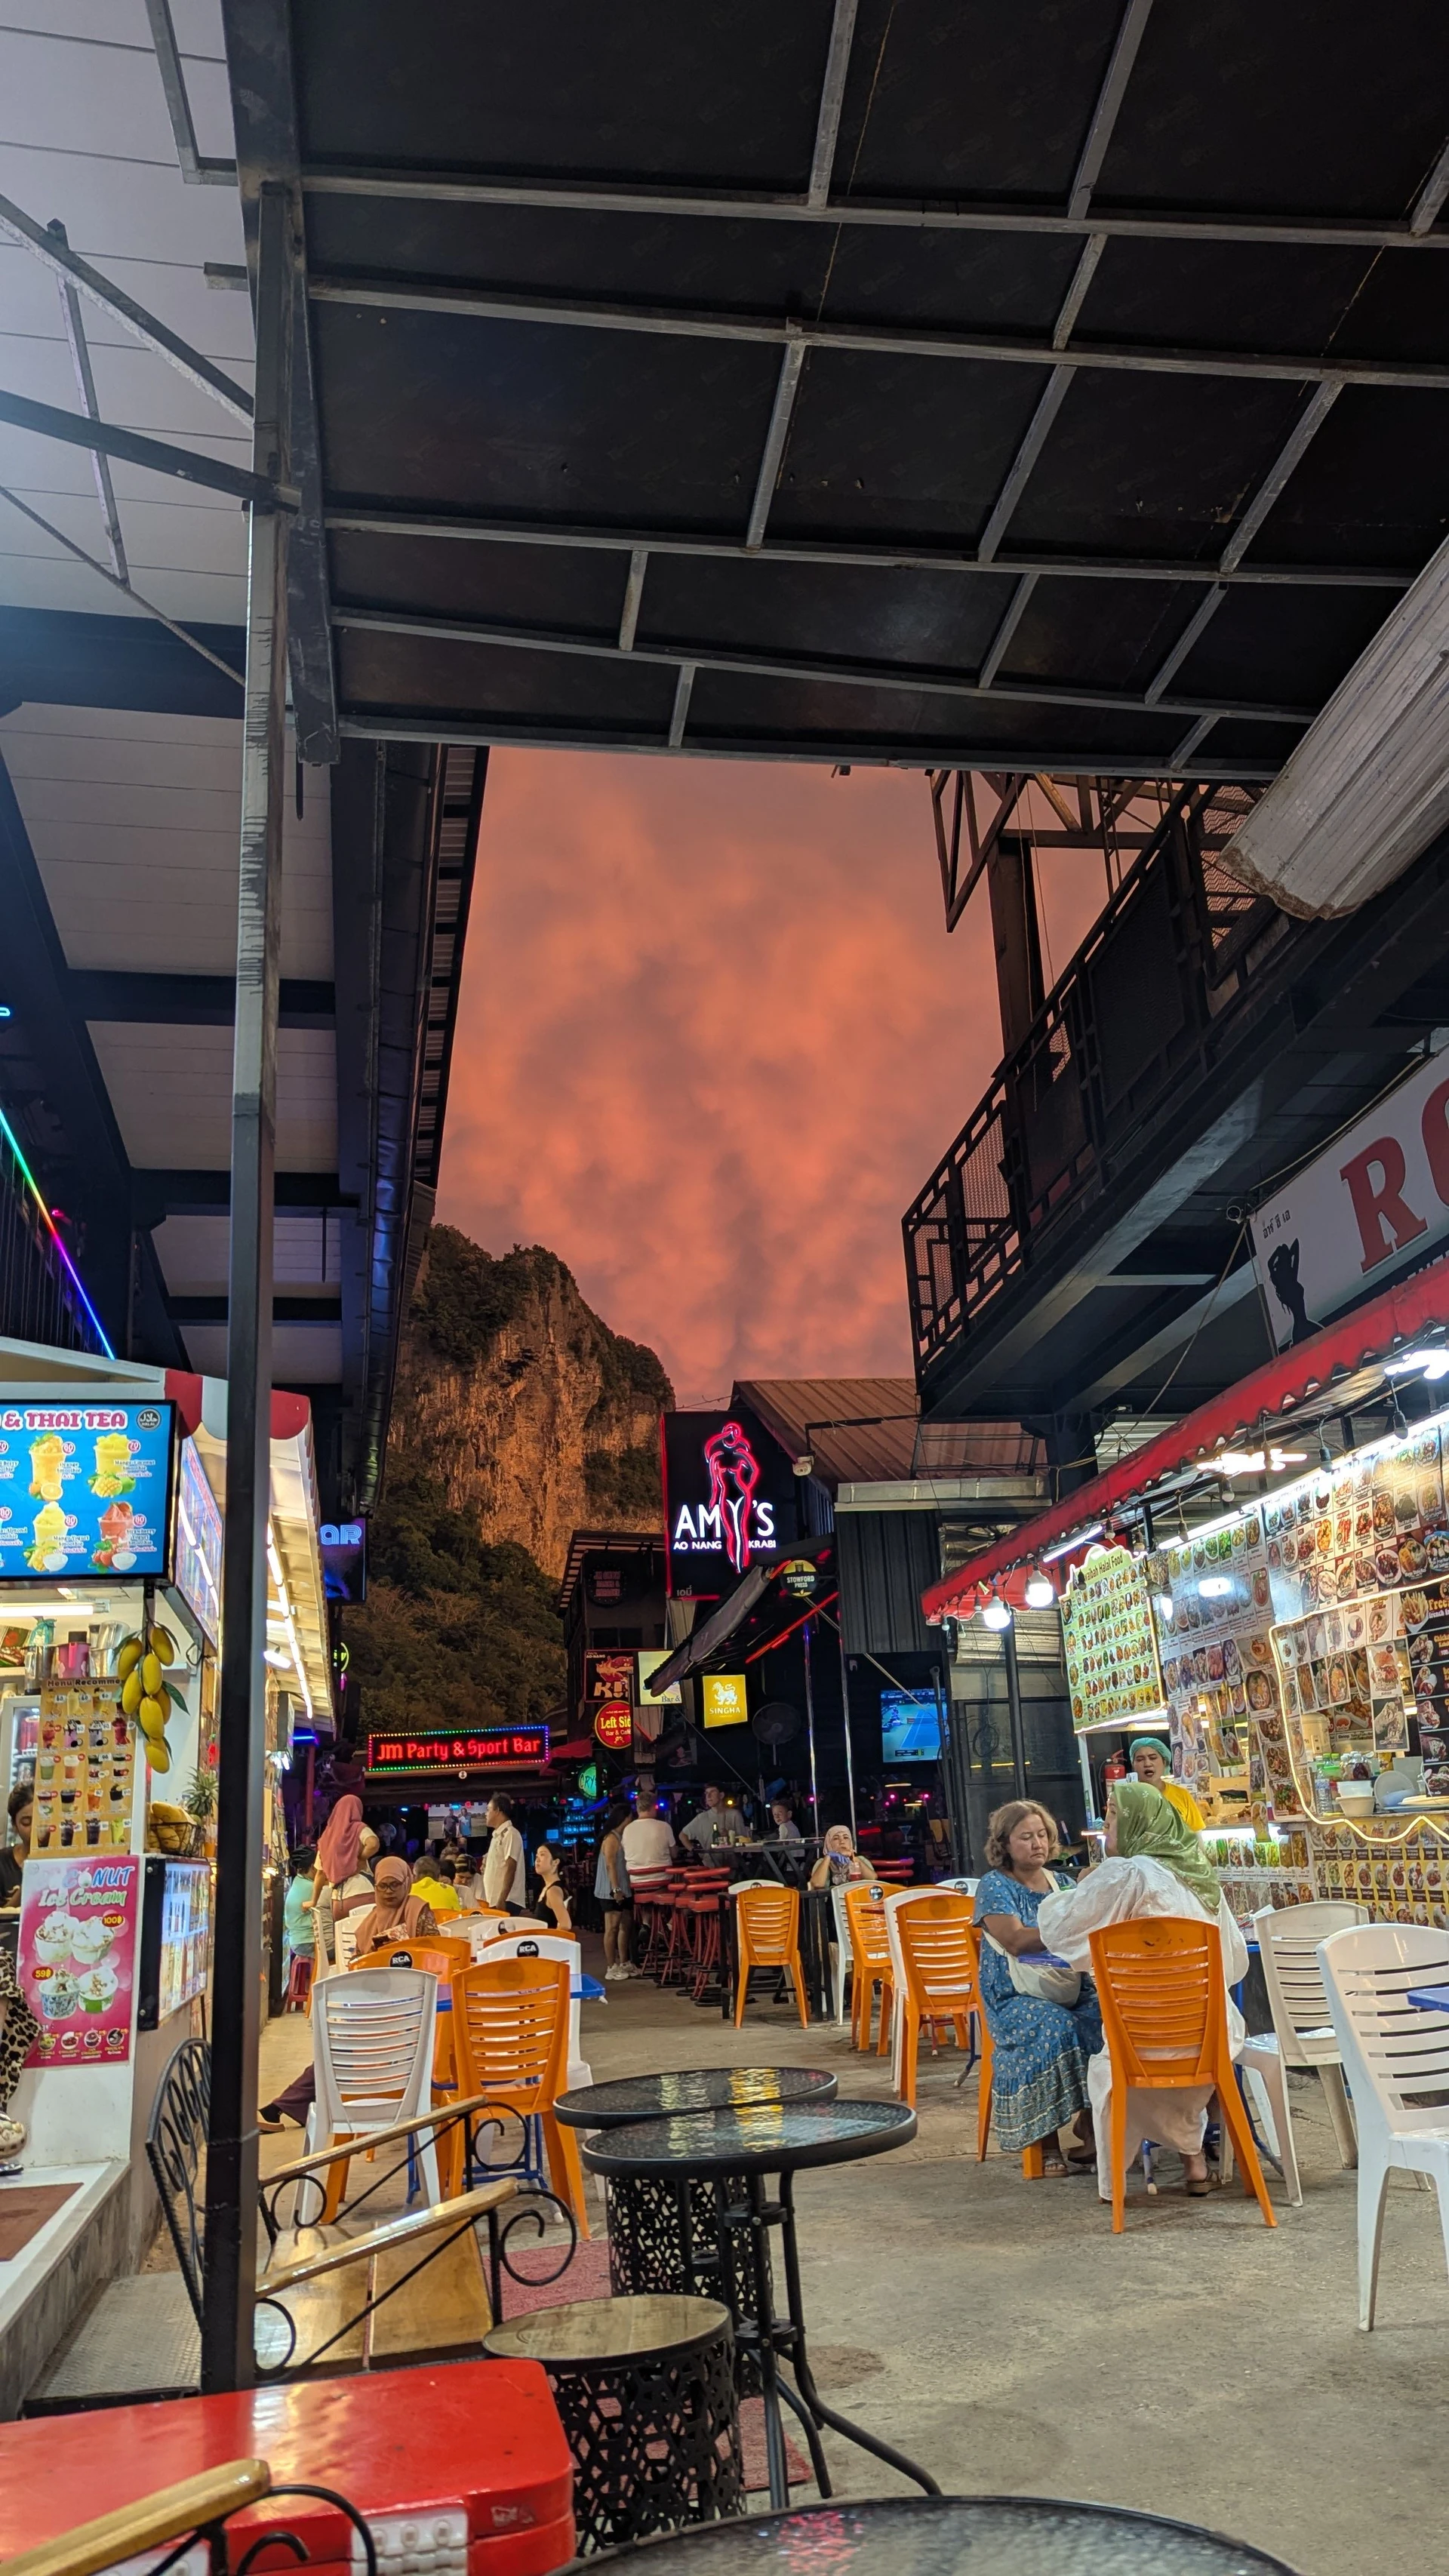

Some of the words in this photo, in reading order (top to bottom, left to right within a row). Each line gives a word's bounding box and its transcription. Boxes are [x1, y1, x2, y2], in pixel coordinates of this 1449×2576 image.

[5, 1412, 21, 1428] &
[26, 1412, 80, 1428] THAI
[85, 1411, 126, 1428] TEA
[673, 1541, 689, 1550] AO
[692, 1540, 722, 1550] NANG
[748, 1540, 776, 1548] KRABI
[786, 1575, 815, 1583] STOWFORD
[709, 1707, 741, 1715] SINGHA
[600, 1716, 617, 1729] Left
[377, 1744, 403, 1760] JM
[407, 1742, 449, 1762] Party
[453, 1741, 465, 1756] &
[467, 1738, 508, 1759] Sport
[512, 1737, 541, 1753] Bar
[38, 1889, 68, 1907] Ice
[69, 1888, 128, 1907] Cream
[518, 1944, 537, 1953] RCA
[392, 1955, 411, 1964] RCA
